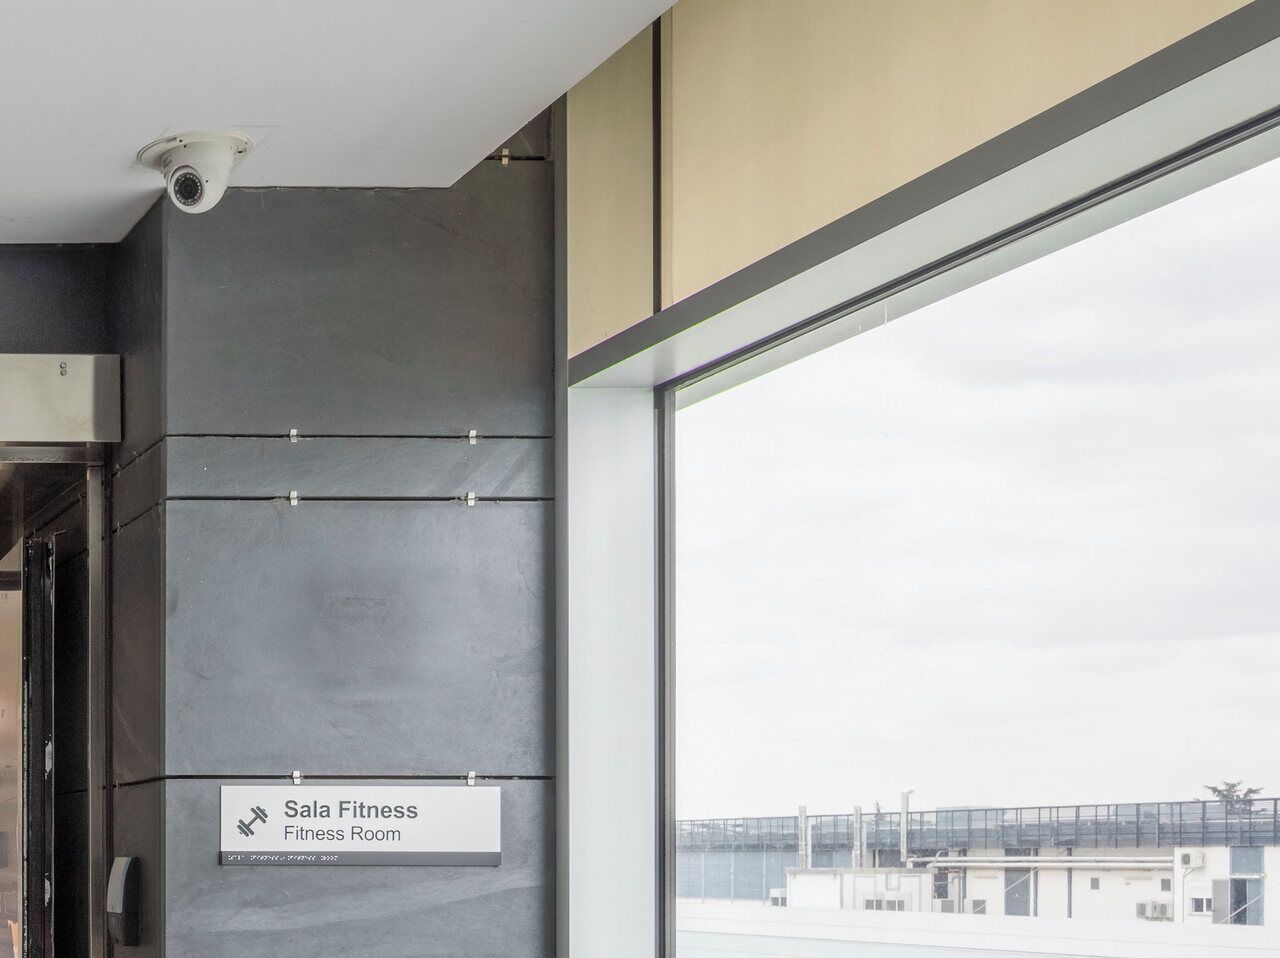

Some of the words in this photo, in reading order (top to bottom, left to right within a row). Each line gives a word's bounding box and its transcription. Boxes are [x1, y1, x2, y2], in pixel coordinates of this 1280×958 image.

[284, 800, 331, 819] Sala
[338, 800, 419, 819] Fitness
[284, 825, 345, 842] Fitness
[350, 825, 402, 842] Room
